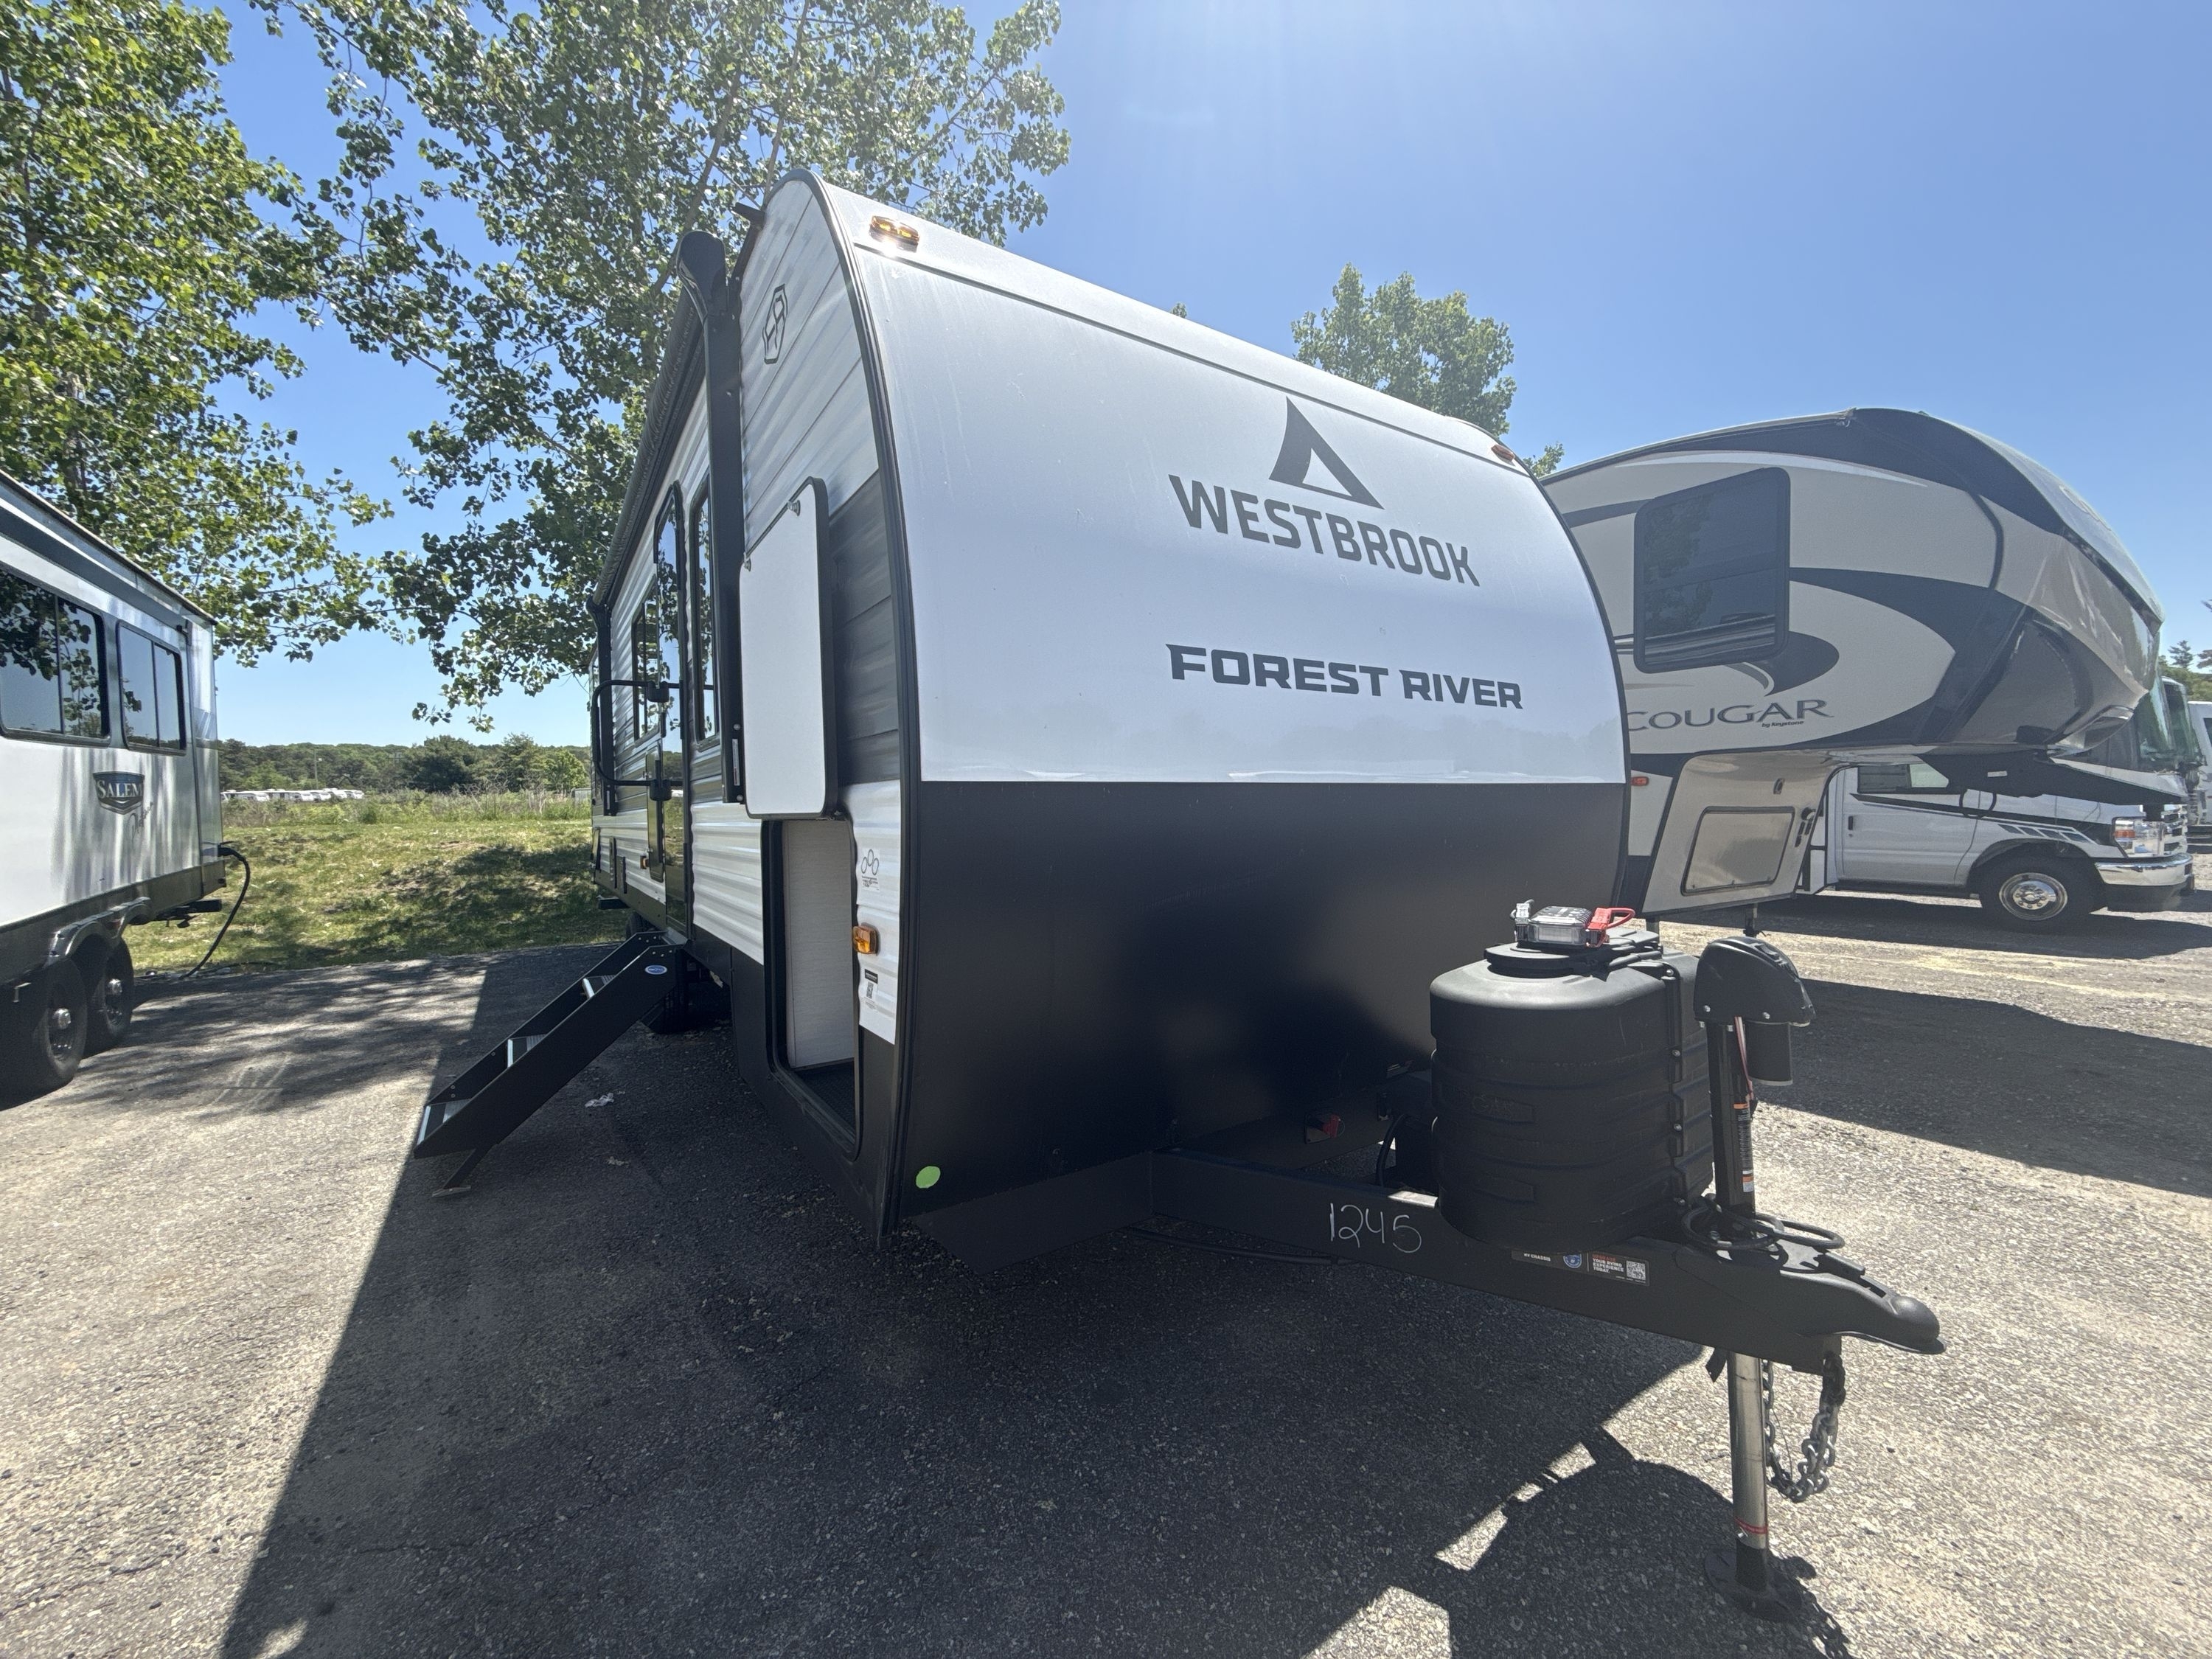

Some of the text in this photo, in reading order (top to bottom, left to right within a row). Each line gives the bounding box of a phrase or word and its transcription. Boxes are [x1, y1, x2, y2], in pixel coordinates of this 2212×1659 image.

[1168, 474, 1480, 587] WESTBROOK
[1165, 643, 1523, 709] FOREST RIVER
[1627, 698, 1835, 731] COUGAR
[97, 779, 143, 799] SALEM
[1329, 1203, 1422, 1253] 1245
[1593, 1262, 1624, 1273] EXPERIENCE
